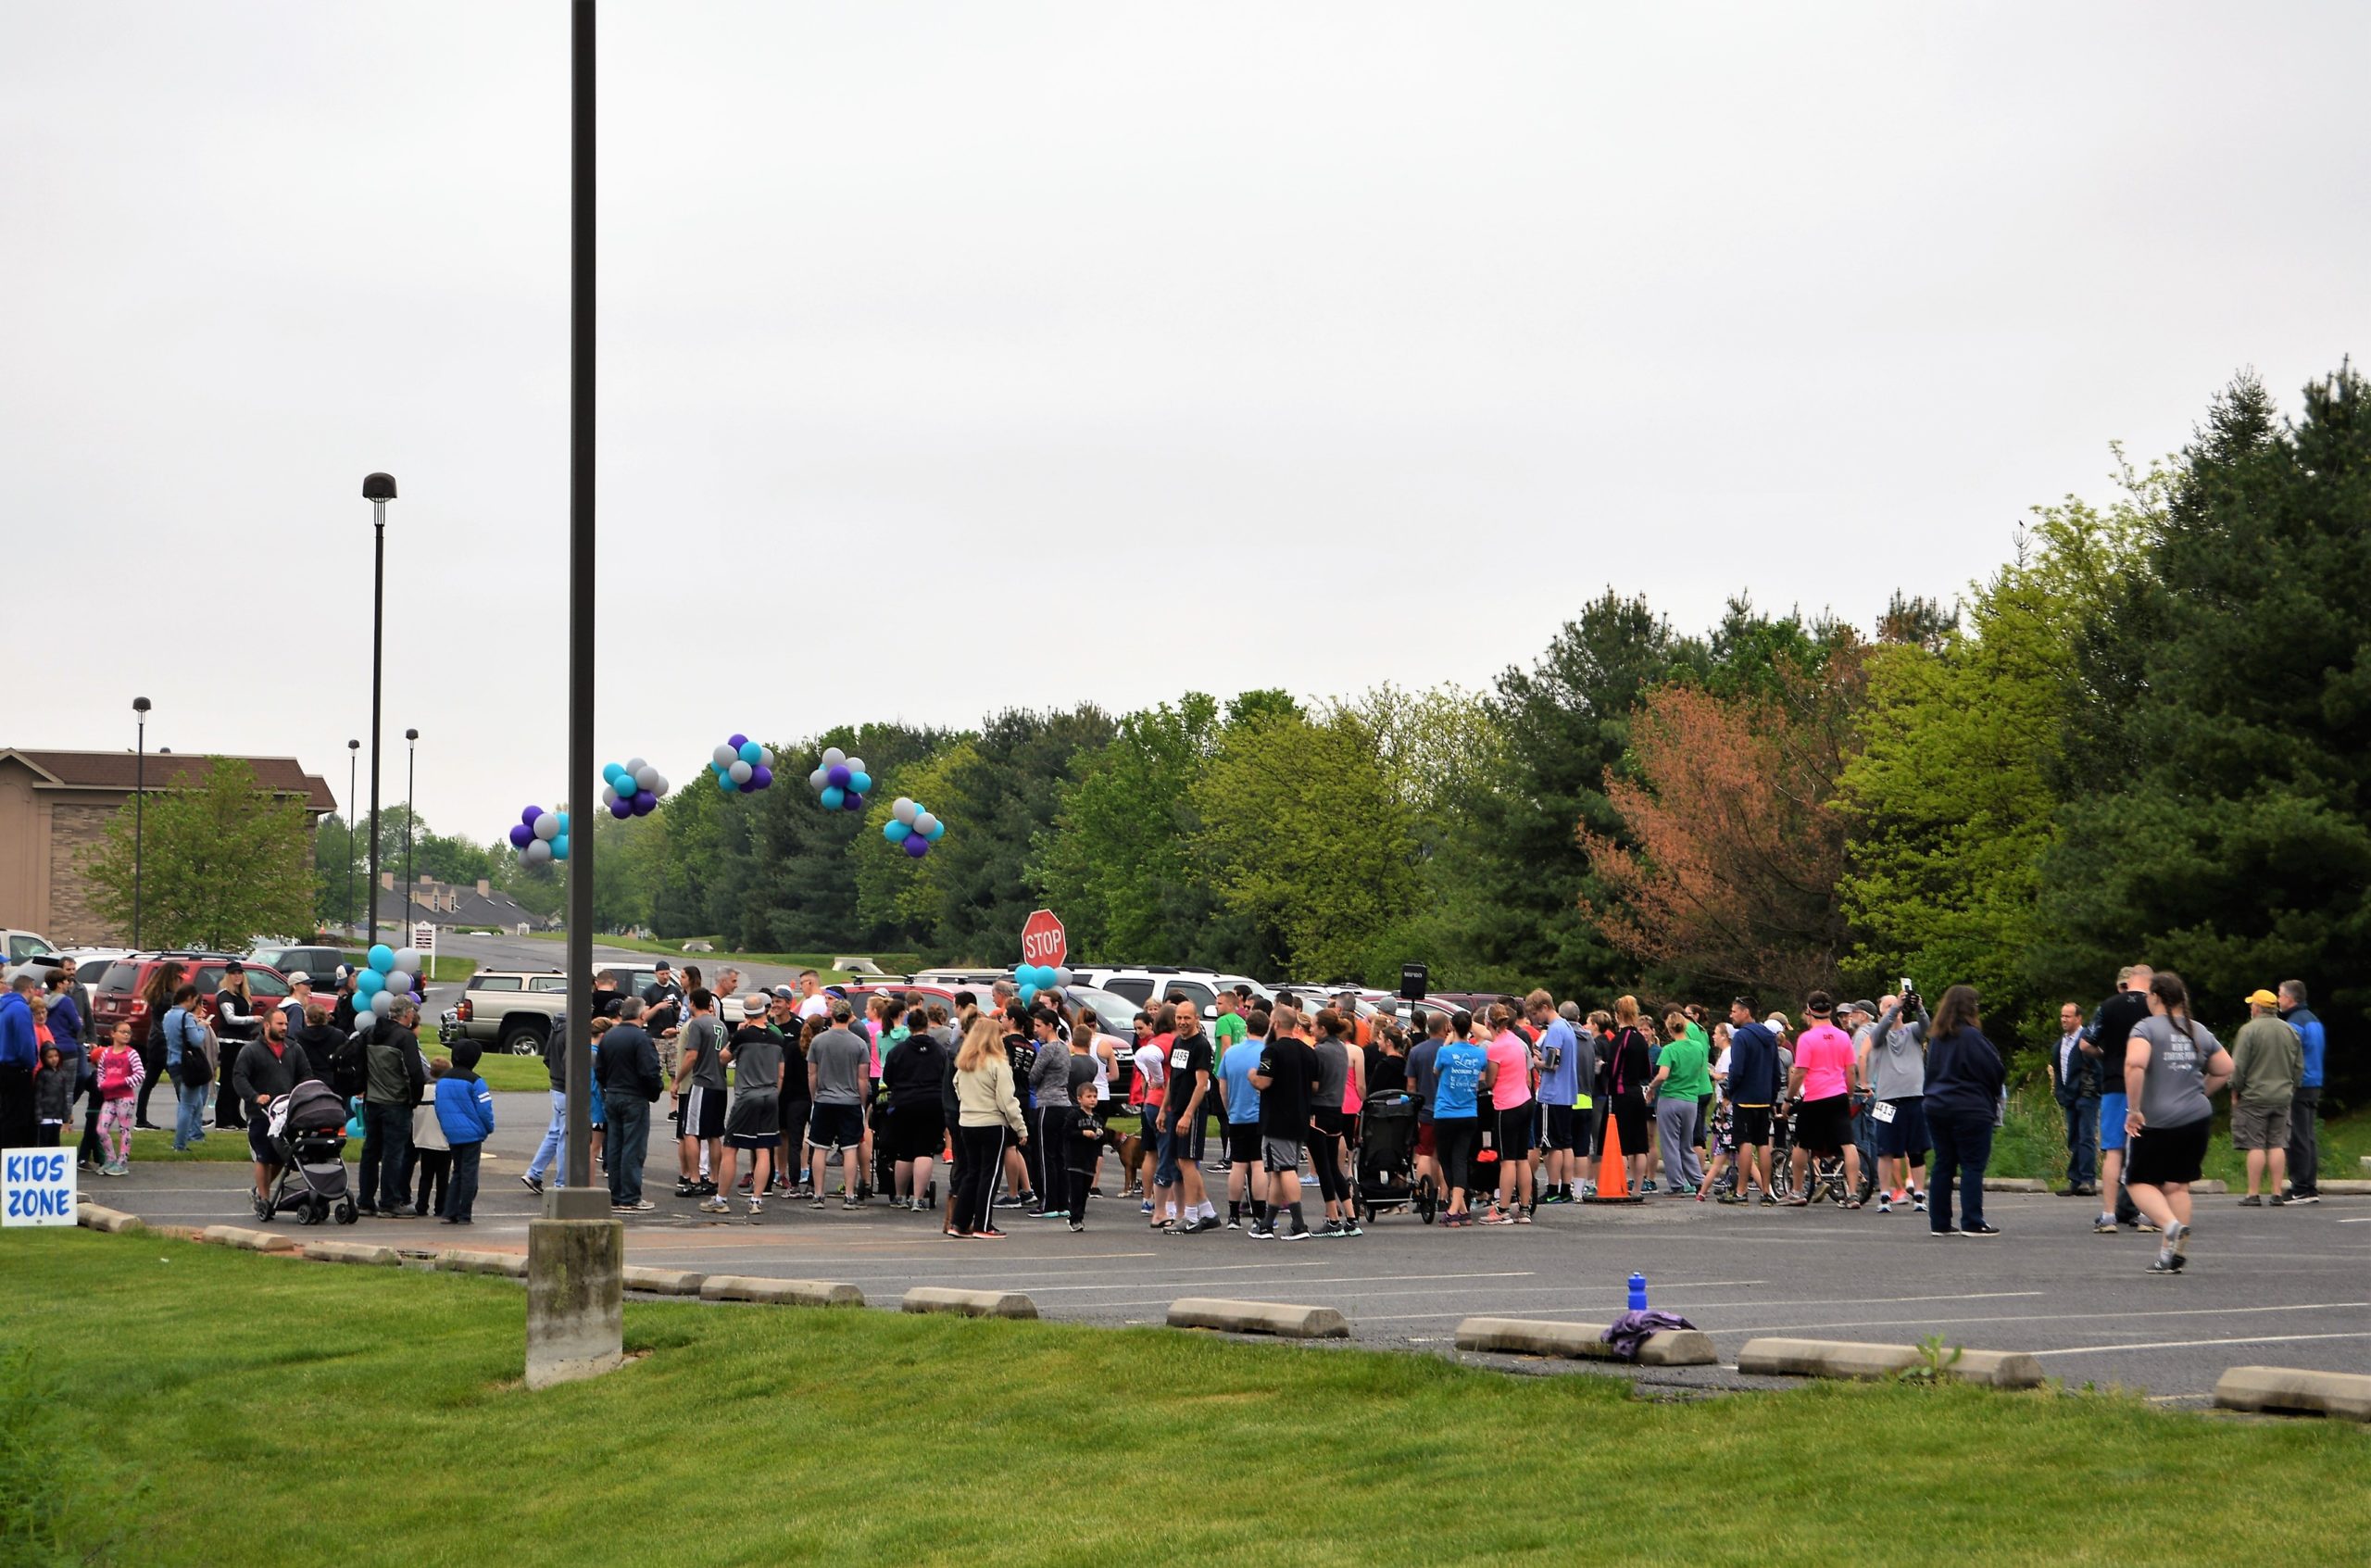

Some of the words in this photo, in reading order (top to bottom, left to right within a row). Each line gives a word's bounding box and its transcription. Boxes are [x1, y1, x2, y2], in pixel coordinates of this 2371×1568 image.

[1025, 929, 1061, 959] STOP
[713, 1024, 723, 1051] 7
[1173, 1051, 1189, 1061] 4495
[1875, 1103, 1896, 1116] 4413
[8, 1188, 69, 1217] ZONE
